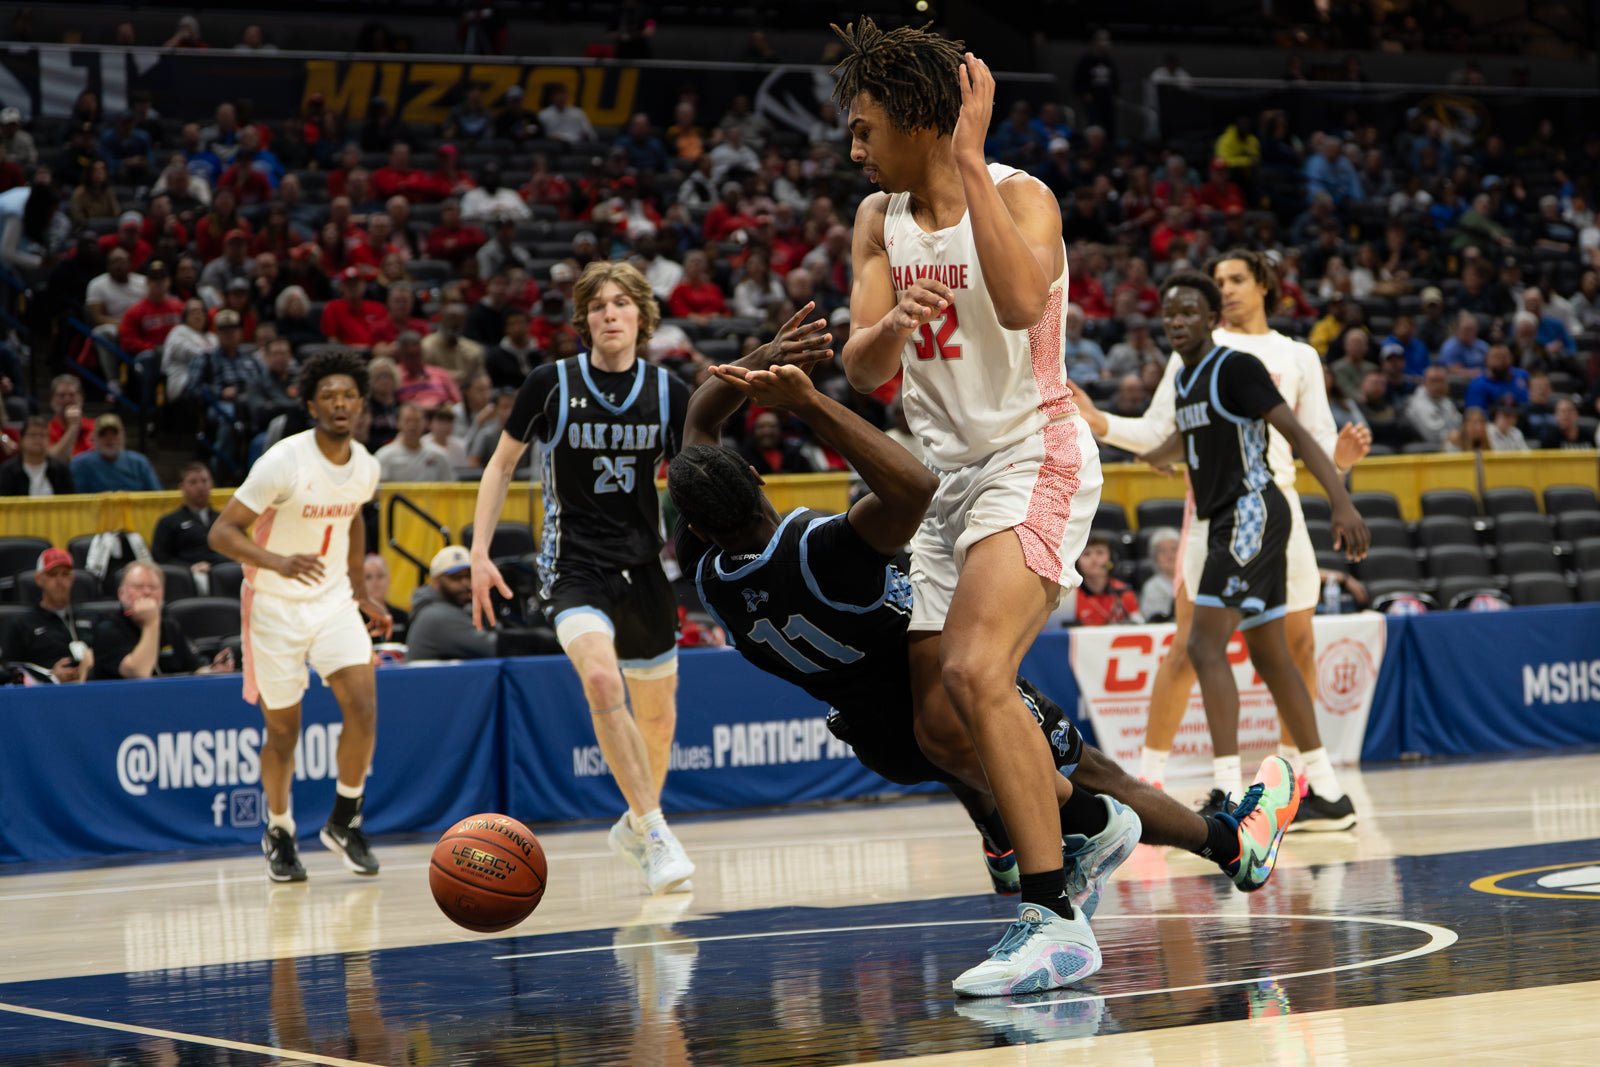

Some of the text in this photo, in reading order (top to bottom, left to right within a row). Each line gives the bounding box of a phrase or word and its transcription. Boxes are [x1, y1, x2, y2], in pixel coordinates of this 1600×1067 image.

[303, 61, 640, 125] MIZZOU
[891, 264, 968, 291] HAMINADE
[568, 423, 660, 450] OAK PARK
[592, 456, 637, 494] 25
[302, 503, 358, 519] CHAMINAD
[317, 524, 333, 556] 1
[747, 613, 866, 674] 11
[1522, 659, 1600, 706] MSHS
[458, 819, 533, 857] SPALDING
[452, 844, 517, 874] LEGACY
